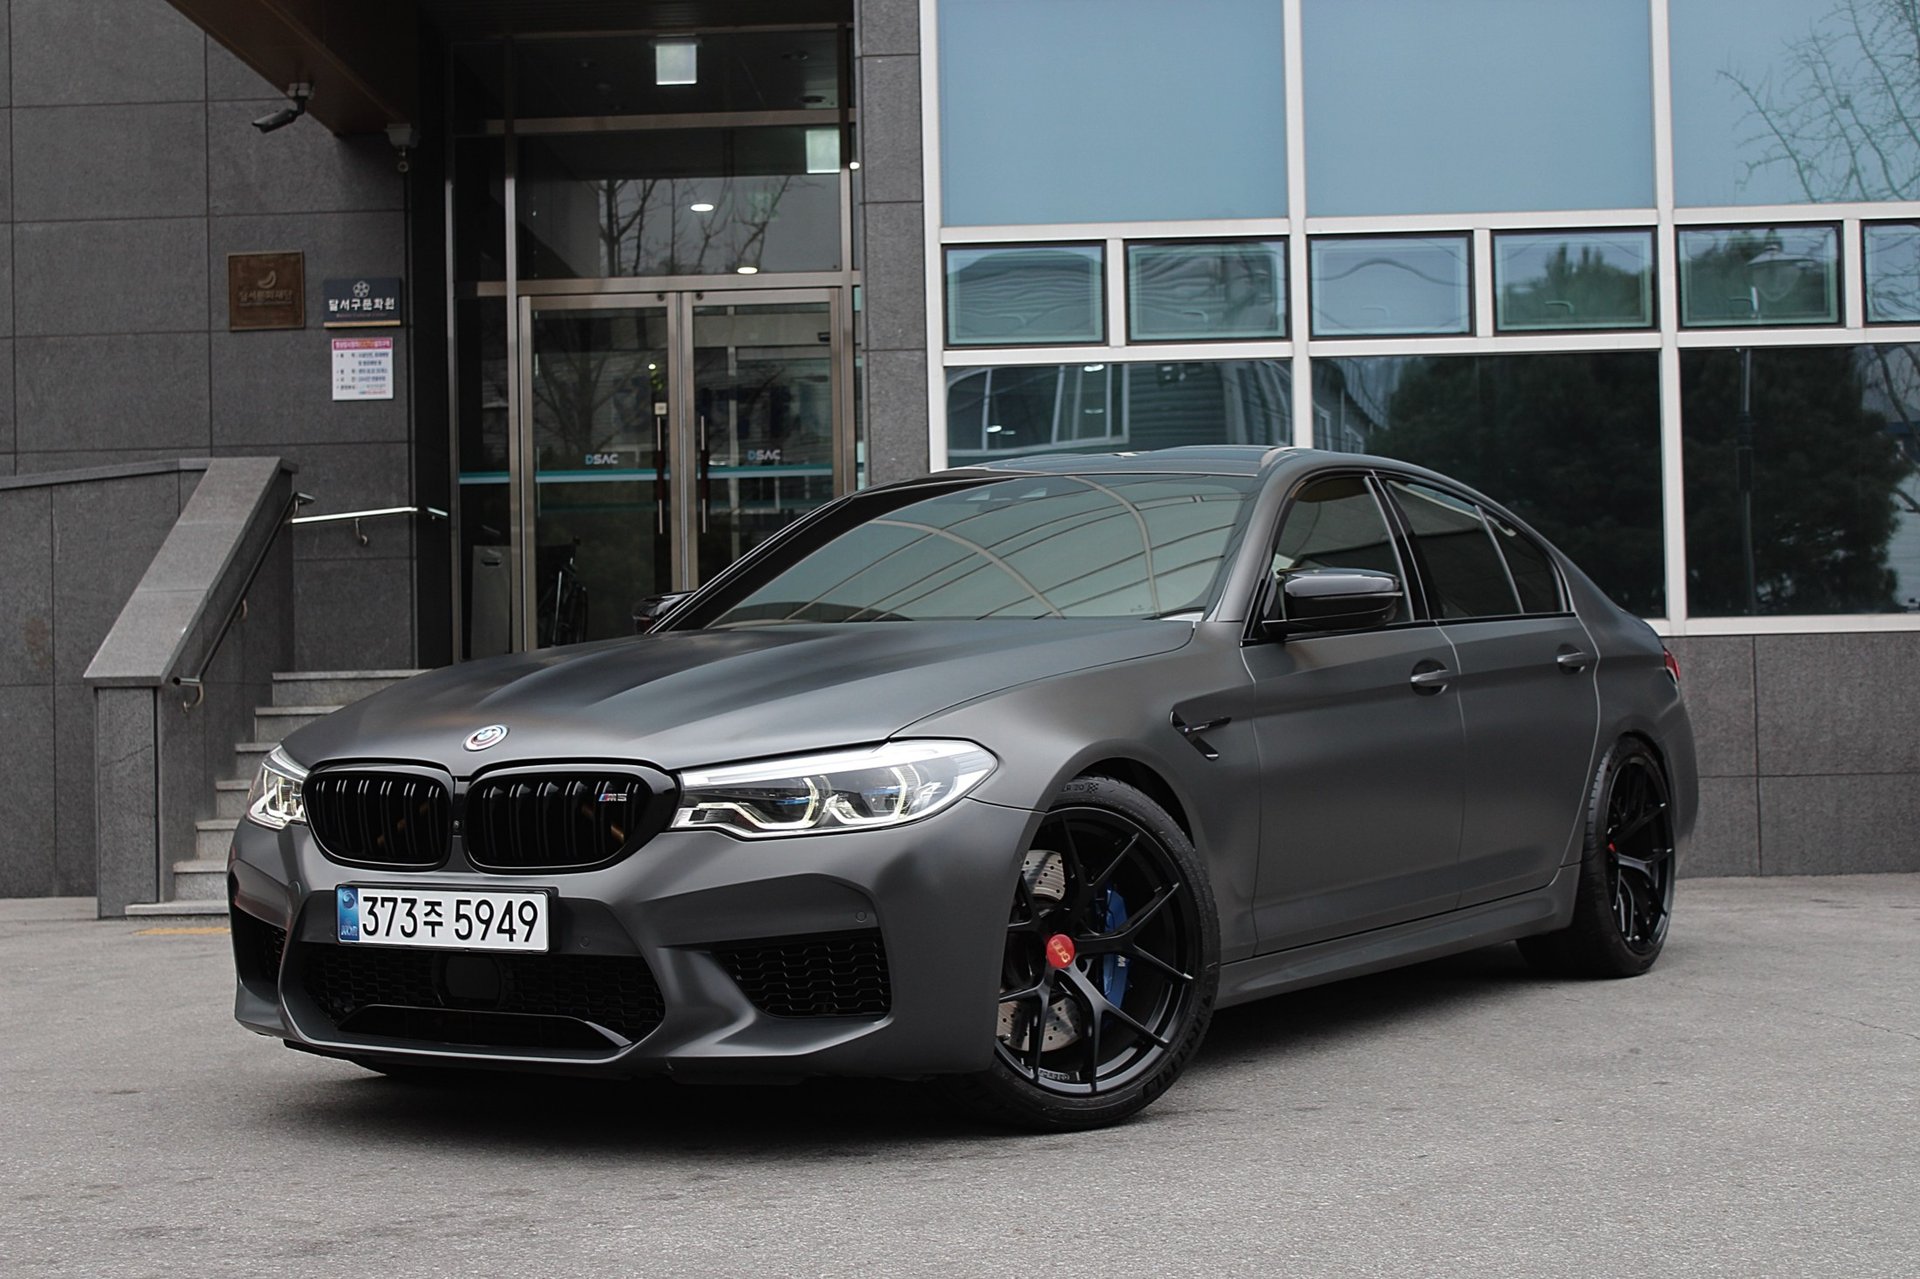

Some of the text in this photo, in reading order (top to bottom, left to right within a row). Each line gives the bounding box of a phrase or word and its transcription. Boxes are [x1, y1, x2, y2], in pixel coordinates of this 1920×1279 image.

[328, 296, 395, 312] 달서구문화원
[585, 453, 619, 465] DSAC
[748, 449, 781, 461] DSAC
[599, 793, 627, 802] M5
[362, 895, 538, 943] 373주 5949
